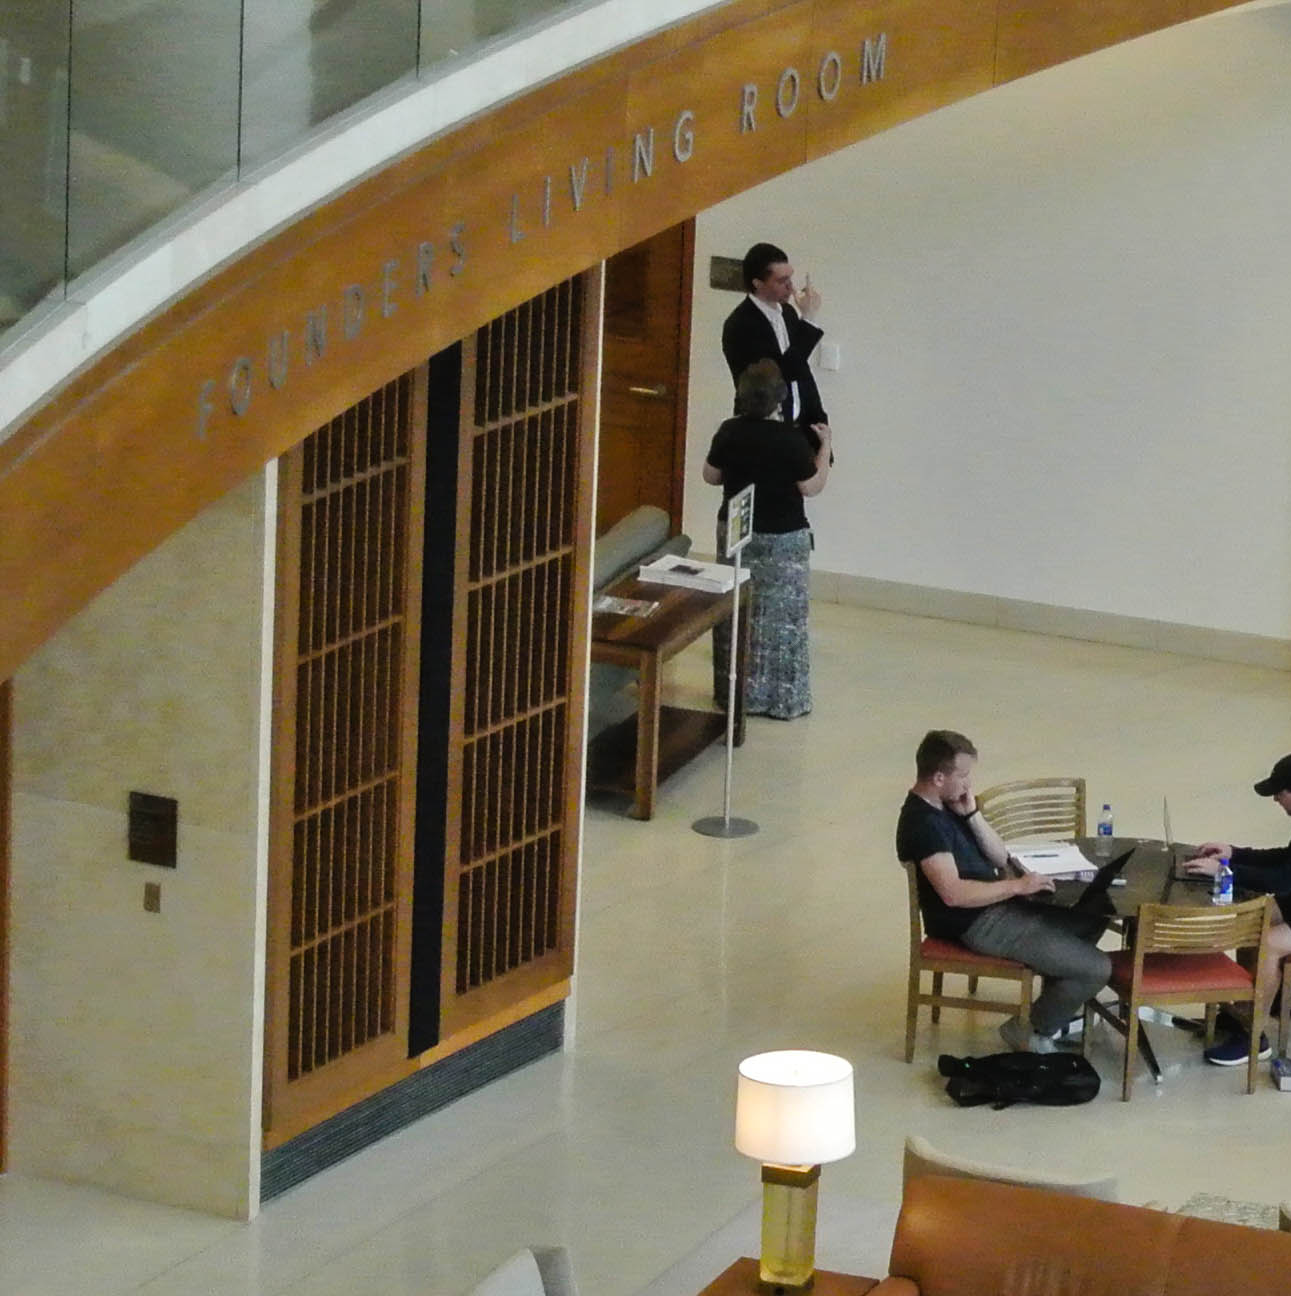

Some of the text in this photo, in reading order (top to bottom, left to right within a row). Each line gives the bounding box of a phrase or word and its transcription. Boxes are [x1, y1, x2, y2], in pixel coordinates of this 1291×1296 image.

[198, 32, 888, 439] FOUNDERS LIVING ROOM
